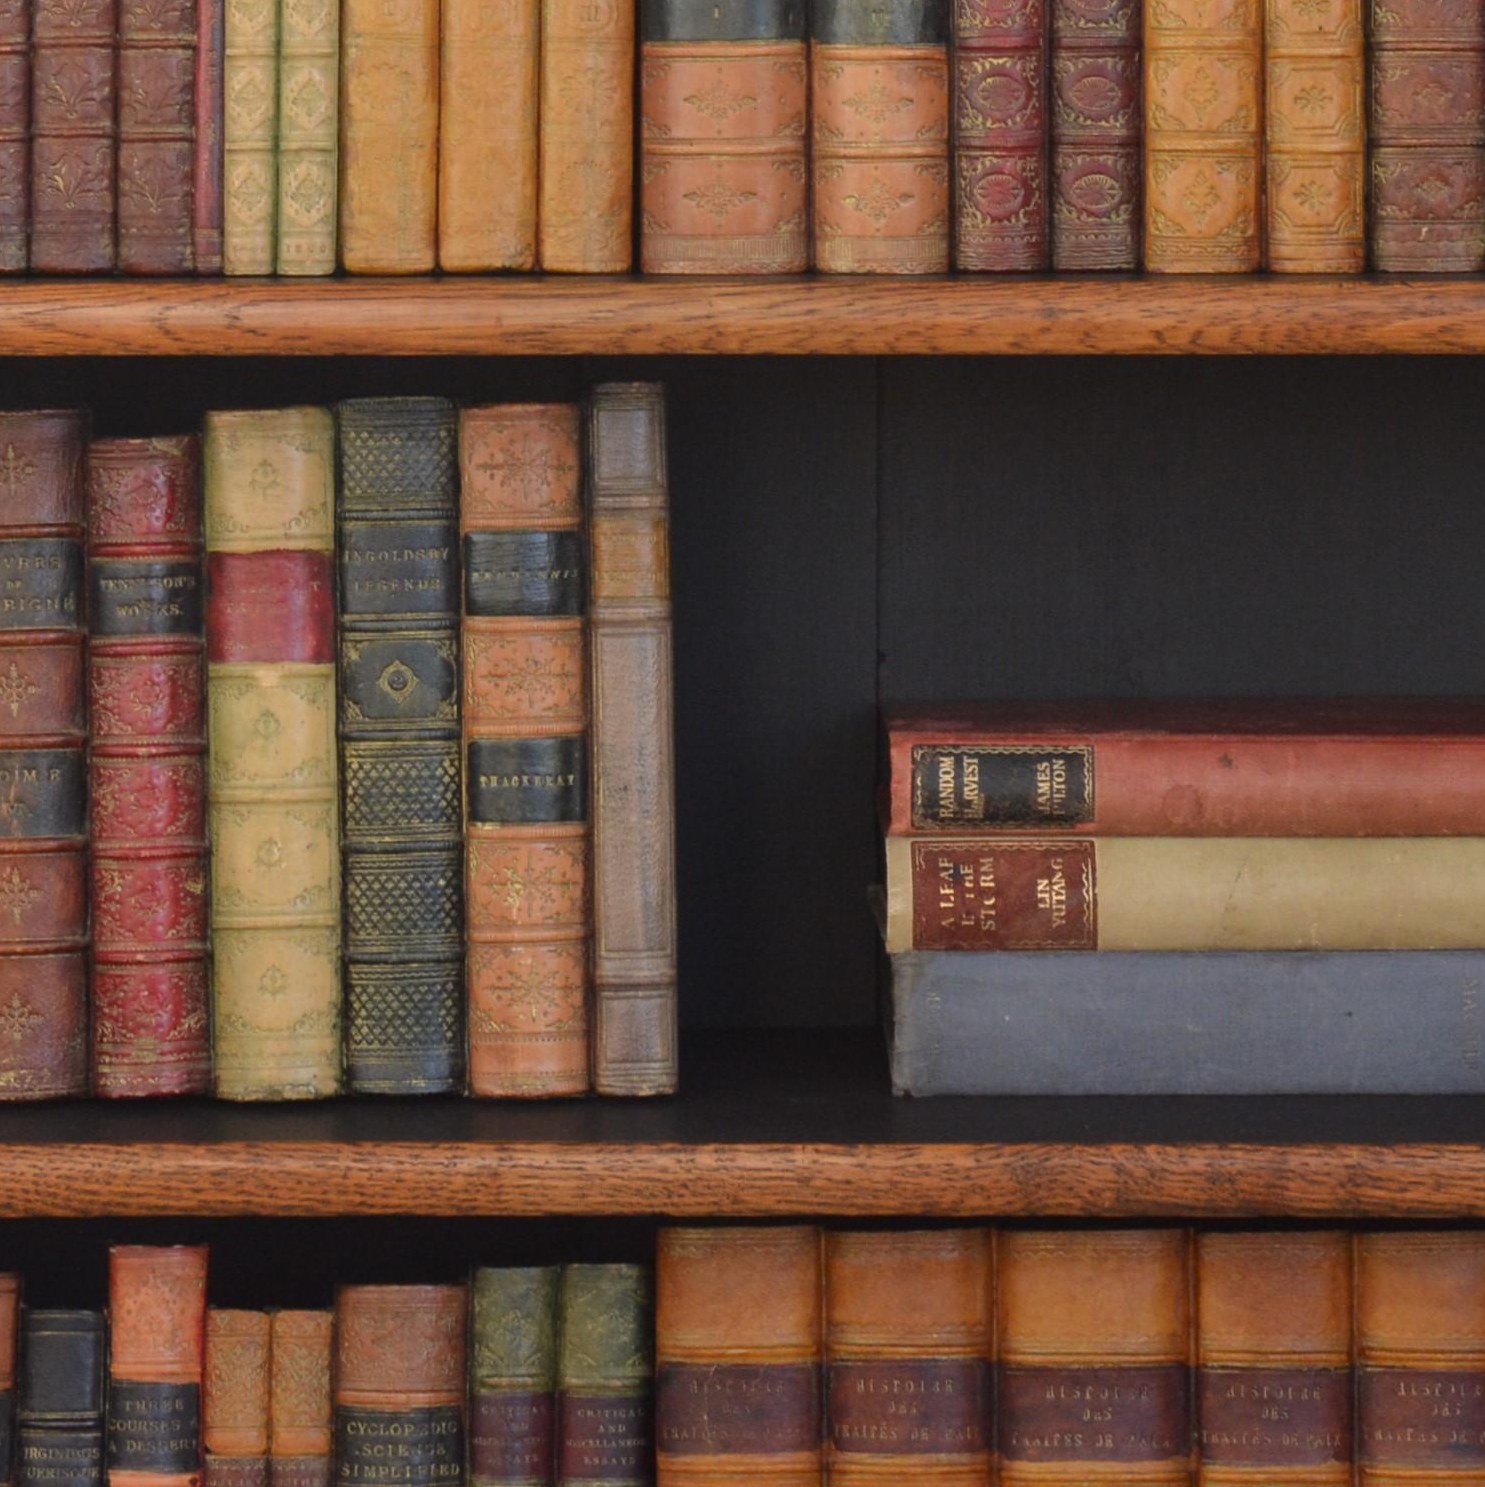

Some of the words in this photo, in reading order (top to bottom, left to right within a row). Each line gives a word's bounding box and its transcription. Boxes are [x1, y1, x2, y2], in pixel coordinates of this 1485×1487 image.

[342, 546, 450, 563] INGOLDSBY
[478, 773, 577, 789] THACKERAY
[938, 755, 955, 819] RANDOM
[1036, 878, 1051, 910] LIN
[124, 1398, 185, 1412] THREE
[597, 1423, 627, 1434] AND
[340, 1461, 461, 1479] SIMPLIFIED
